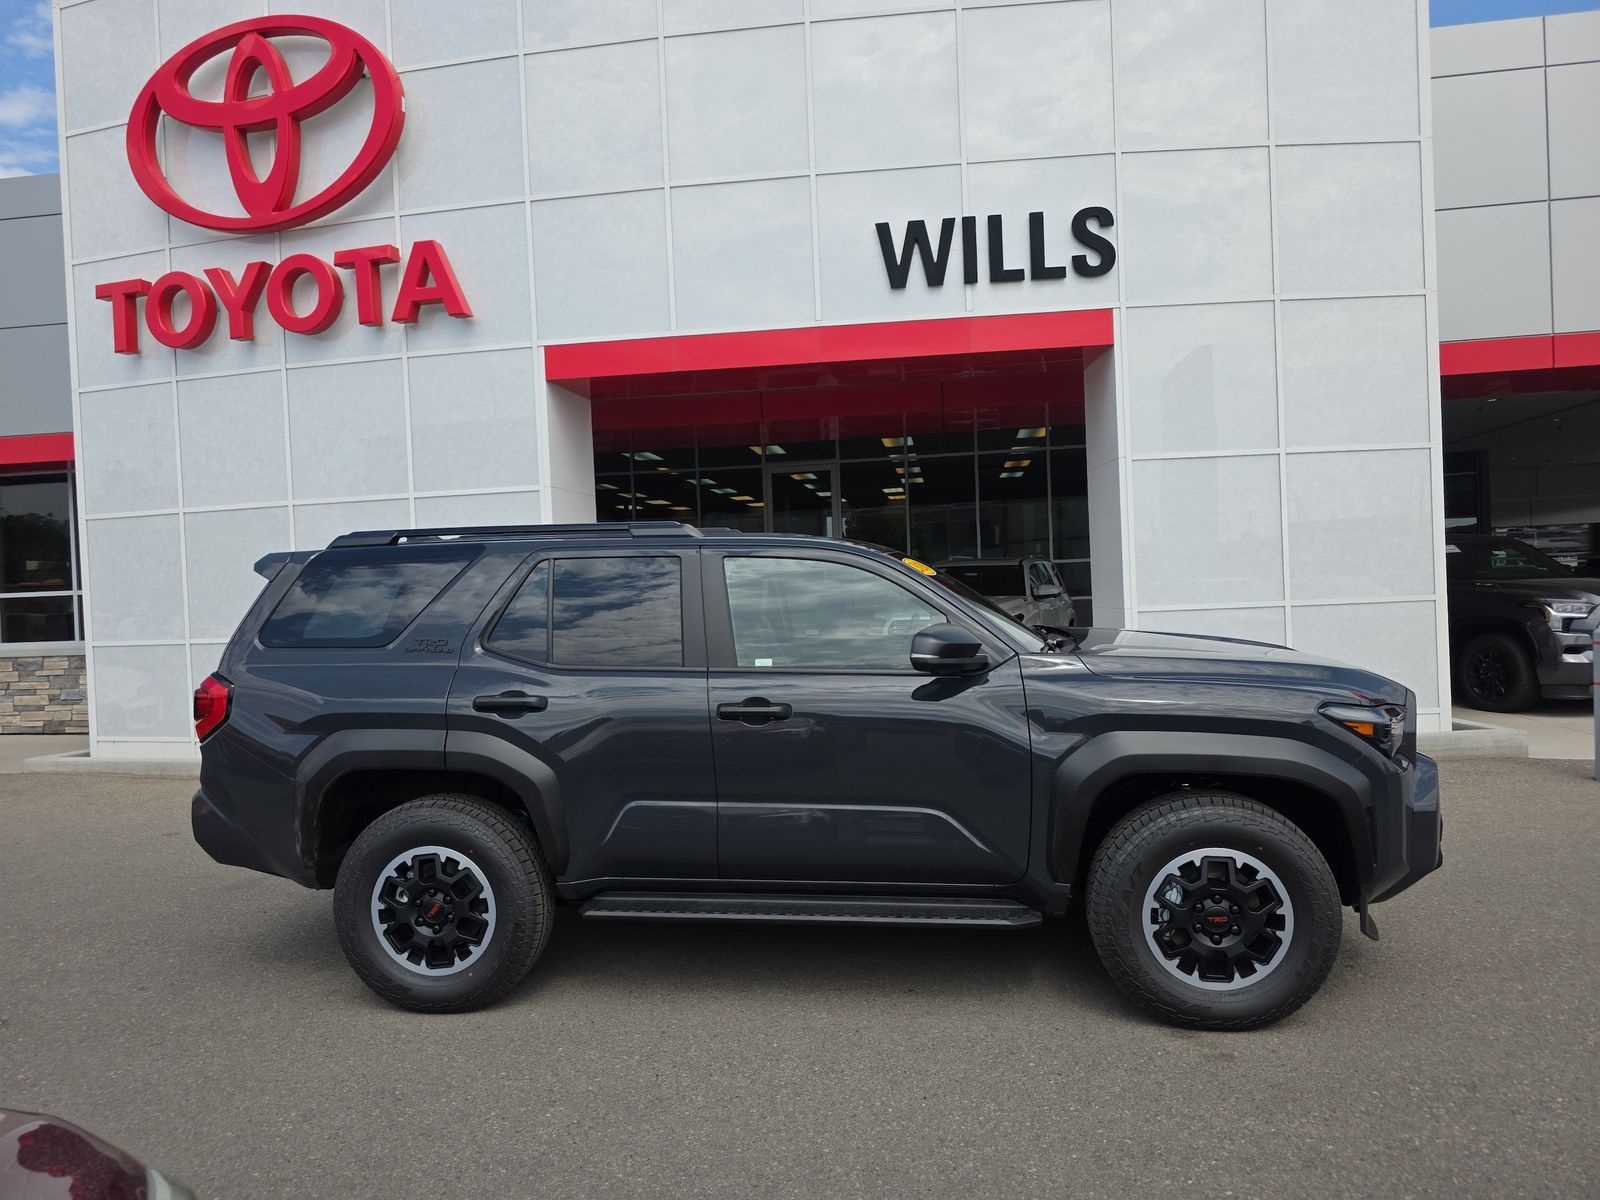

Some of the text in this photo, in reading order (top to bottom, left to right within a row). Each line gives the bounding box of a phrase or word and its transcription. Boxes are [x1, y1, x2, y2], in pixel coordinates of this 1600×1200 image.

[875, 206, 1117, 289] WILLS
[95, 239, 474, 355] TOYOTA
[414, 638, 449, 648] TRD
